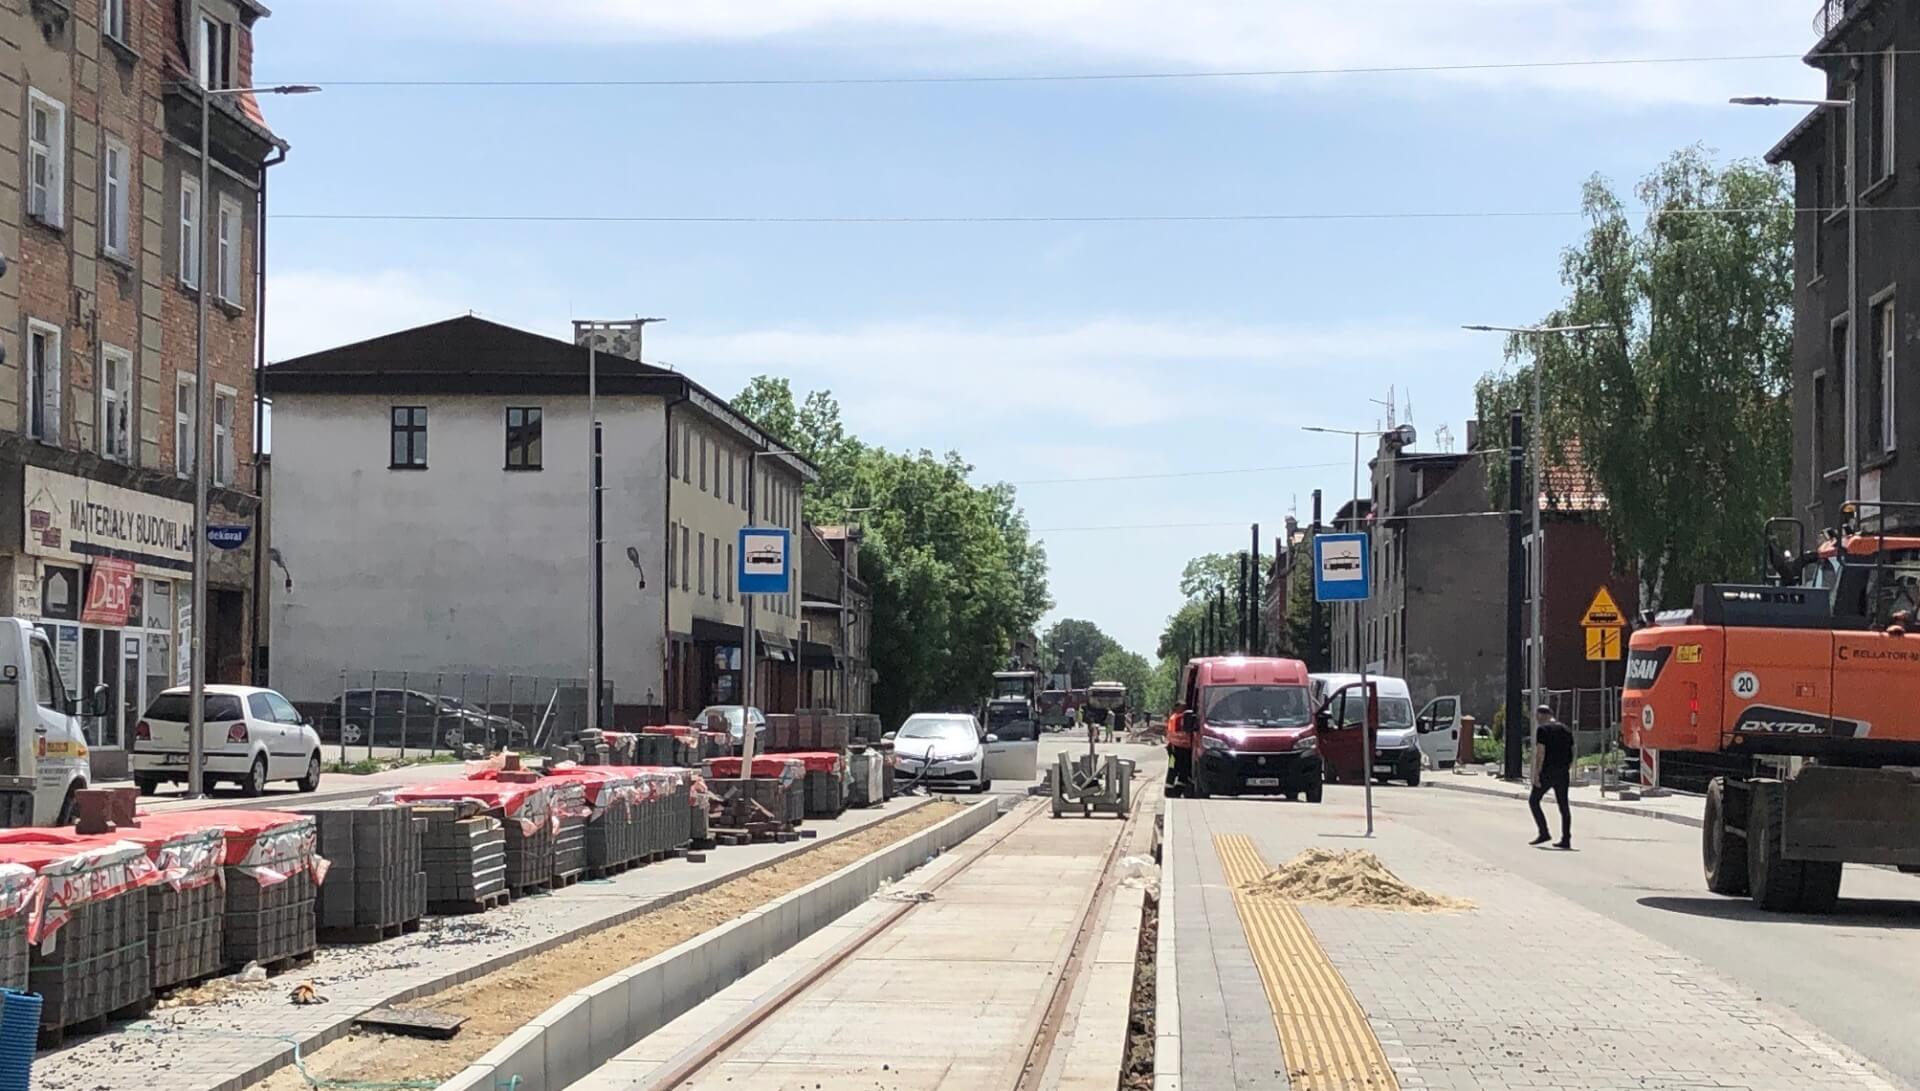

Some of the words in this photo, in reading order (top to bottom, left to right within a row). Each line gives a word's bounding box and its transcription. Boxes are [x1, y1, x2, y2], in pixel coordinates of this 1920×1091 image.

[70, 499, 135, 540] MATERIAŁY
[208, 529, 242, 541] dekoral
[1738, 677, 1753, 692] 20
